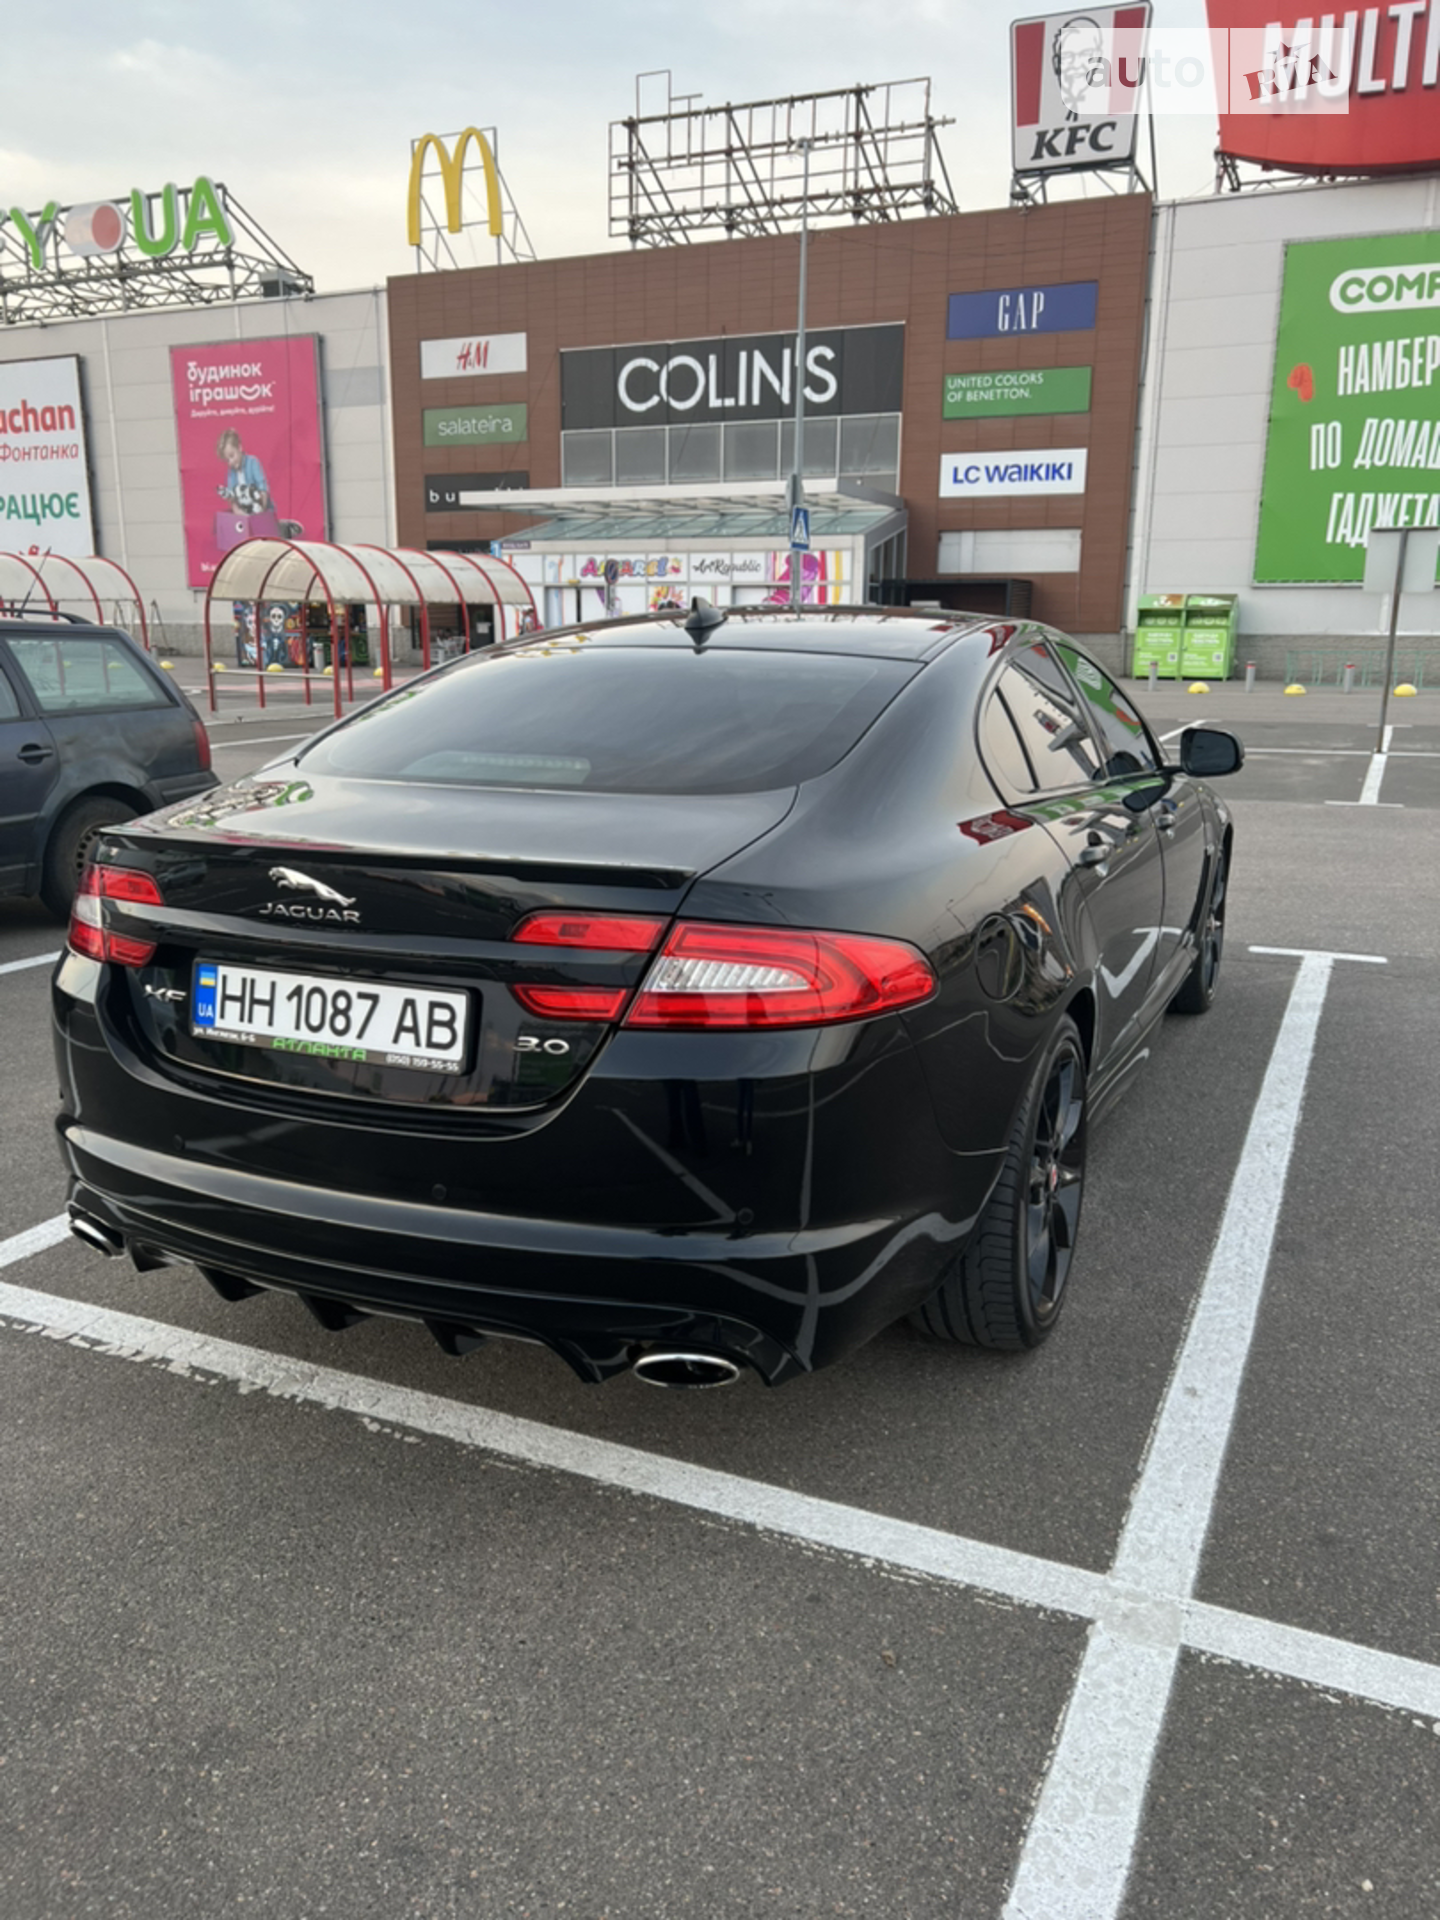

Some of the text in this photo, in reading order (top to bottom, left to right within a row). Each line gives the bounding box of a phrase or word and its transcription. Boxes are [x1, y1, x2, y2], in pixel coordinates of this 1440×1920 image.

[1030, 121, 1117, 161] KFC
[130, 175, 235, 258] UA
[998, 291, 1044, 331] GAP
[187, 361, 262, 386] будинок
[618, 336, 838, 413] COLIN'S
[1337, 334, 1440, 396] НАМБЕР
[947, 373, 1044, 389] UNITED COLORS
[947, 391, 964, 403] OF
[438, 415, 513, 436] salateira
[1310, 420, 1343, 471] ПО
[952, 465, 981, 485] LC
[259, 902, 361, 924] JAGUAR
[198, 1002, 215, 1019] UA
[218, 973, 459, 1052] HH 1087 AB
[512, 1035, 570, 1055] 3.0
